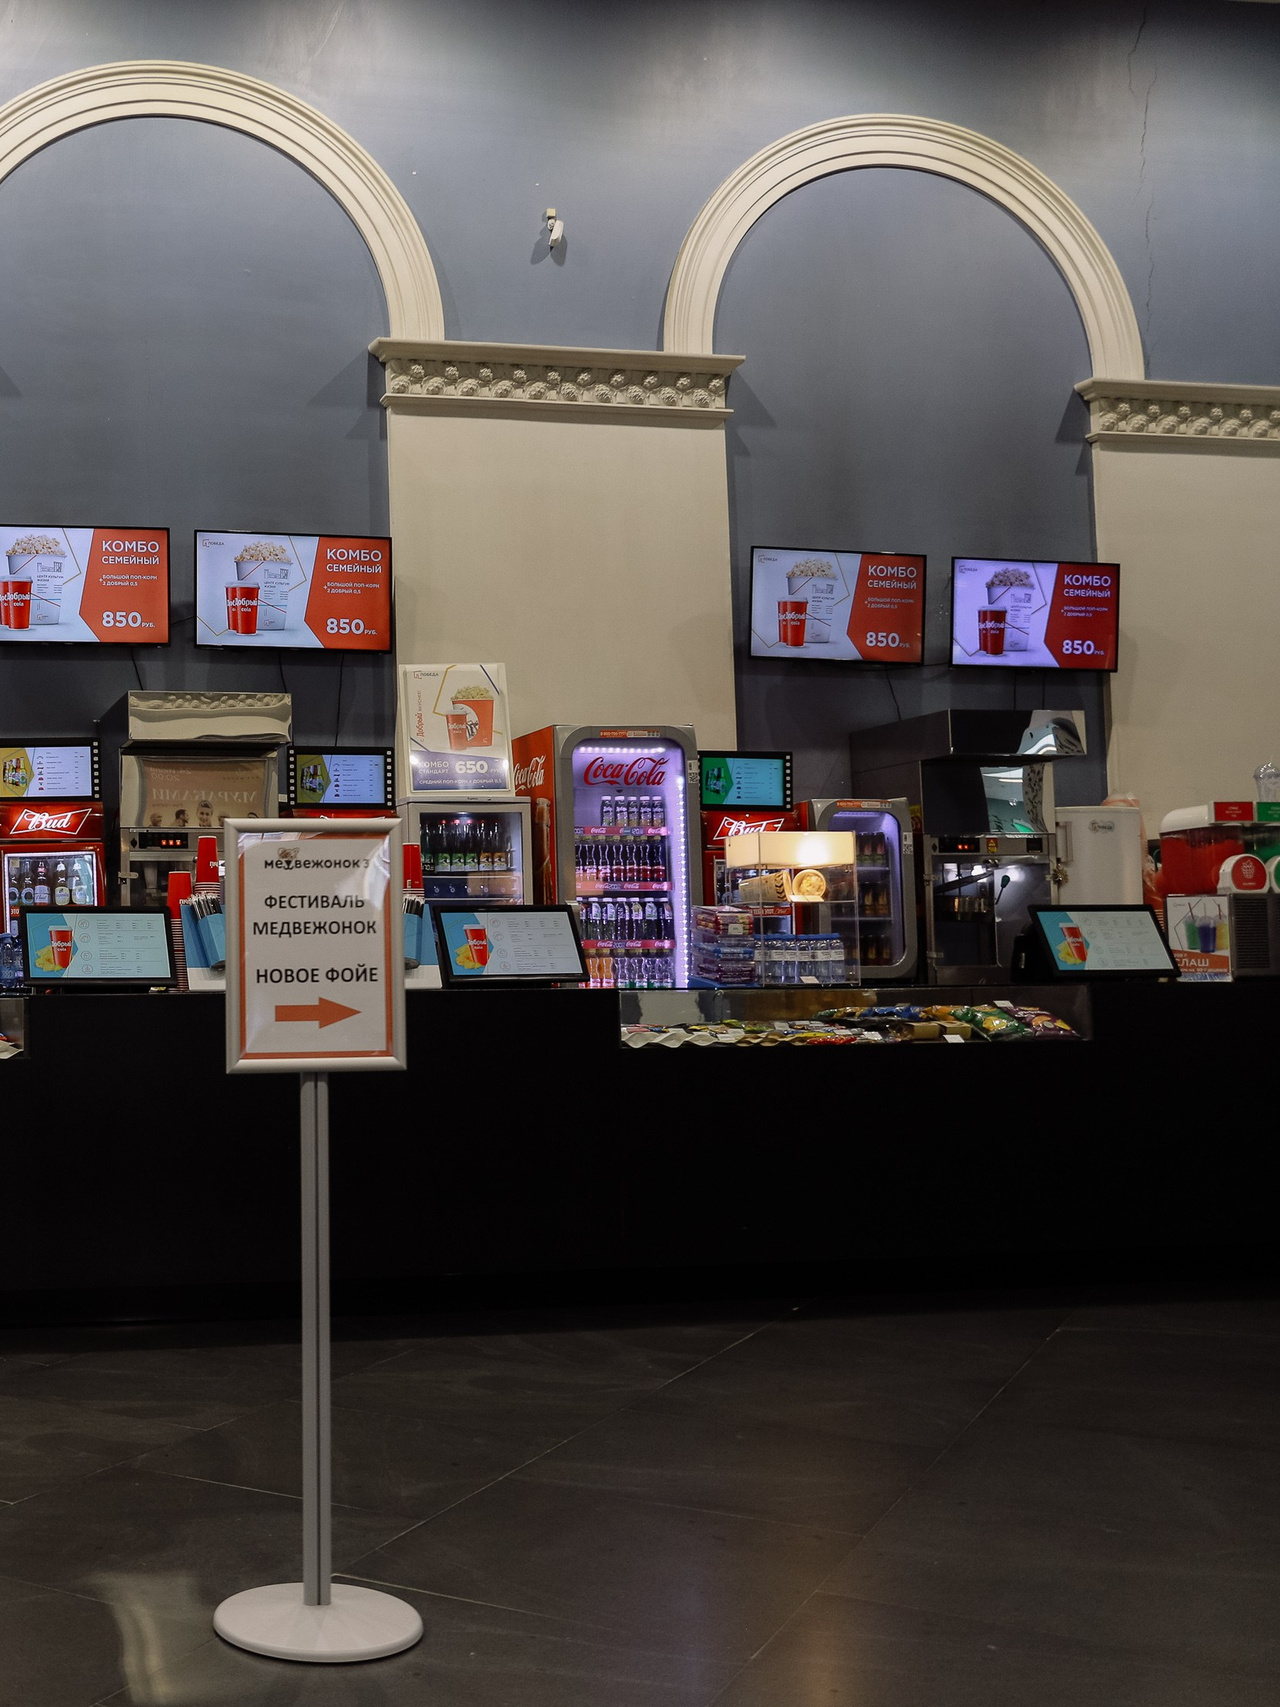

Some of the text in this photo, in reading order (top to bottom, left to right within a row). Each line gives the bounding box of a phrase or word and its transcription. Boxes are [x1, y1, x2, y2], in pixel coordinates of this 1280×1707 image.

[102, 540, 160, 553] КОМБО
[102, 555, 160, 565] СЕМЕЙНЫЙ
[326, 548, 382, 562] КОМБО
[326, 563, 382, 573] СЕМЕЙНЫЙ
[868, 565, 917, 578] КОМБО
[867, 579, 917, 590] СЕМЕЙНЫЙ
[1064, 575, 1111, 587] КОМБО
[1063, 588, 1111, 598] СЕМЕЙНЫЙ
[101, 611, 142, 628] 850
[326, 618, 365, 635] 850
[865, 631, 900, 647] 850
[1062, 639, 1095, 655] 850
[418, 760, 449, 768] КОМБО
[455, 760, 488, 774] 650
[513, 753, 547, 793] Coca-Cola
[583, 756, 670, 787] Coca-Cola
[24, 812, 73, 831] Bud
[264, 894, 365, 909] ФЕСТИВАЛЬ
[252, 920, 377, 938] МЕДВЕЖОНОК
[1177, 958, 1210, 967] СЛАШ
[256, 963, 379, 984] НОВОЕ ФОЙЕ
